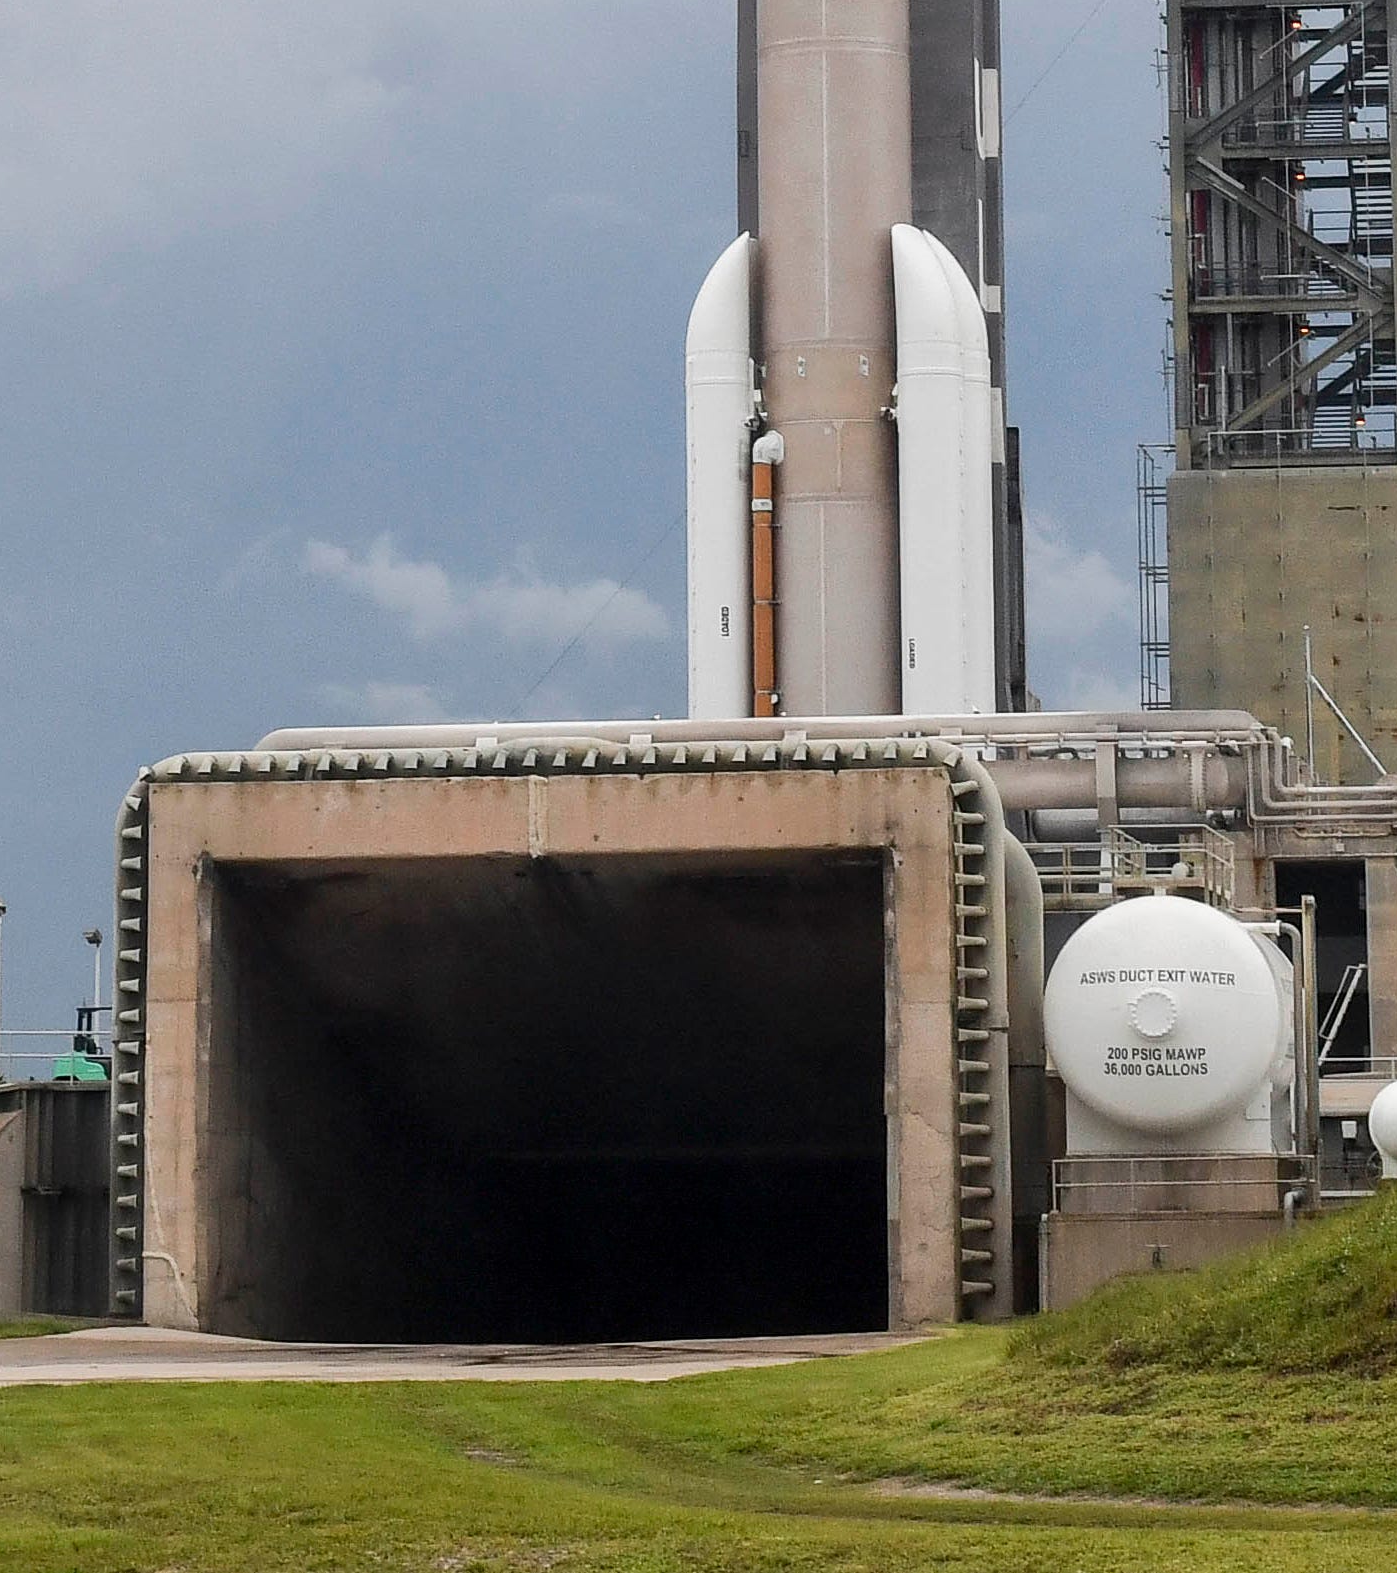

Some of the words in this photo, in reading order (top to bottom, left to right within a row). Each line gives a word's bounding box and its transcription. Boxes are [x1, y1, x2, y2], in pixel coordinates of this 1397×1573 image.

[721, 606, 730, 637] LOADED
[1080, 971, 1116, 985] ASWS
[1119, 969, 1154, 982] DUCT
[1158, 969, 1186, 982] EXIT
[1190, 971, 1236, 985] WATER
[1107, 1047, 1128, 1060] 200
[1132, 1048, 1162, 1060] PSIG
[1166, 1048, 1206, 1060] MAWP
[1104, 1063, 1142, 1076] 36,000
[1145, 1063, 1208, 1076] GALLONS
